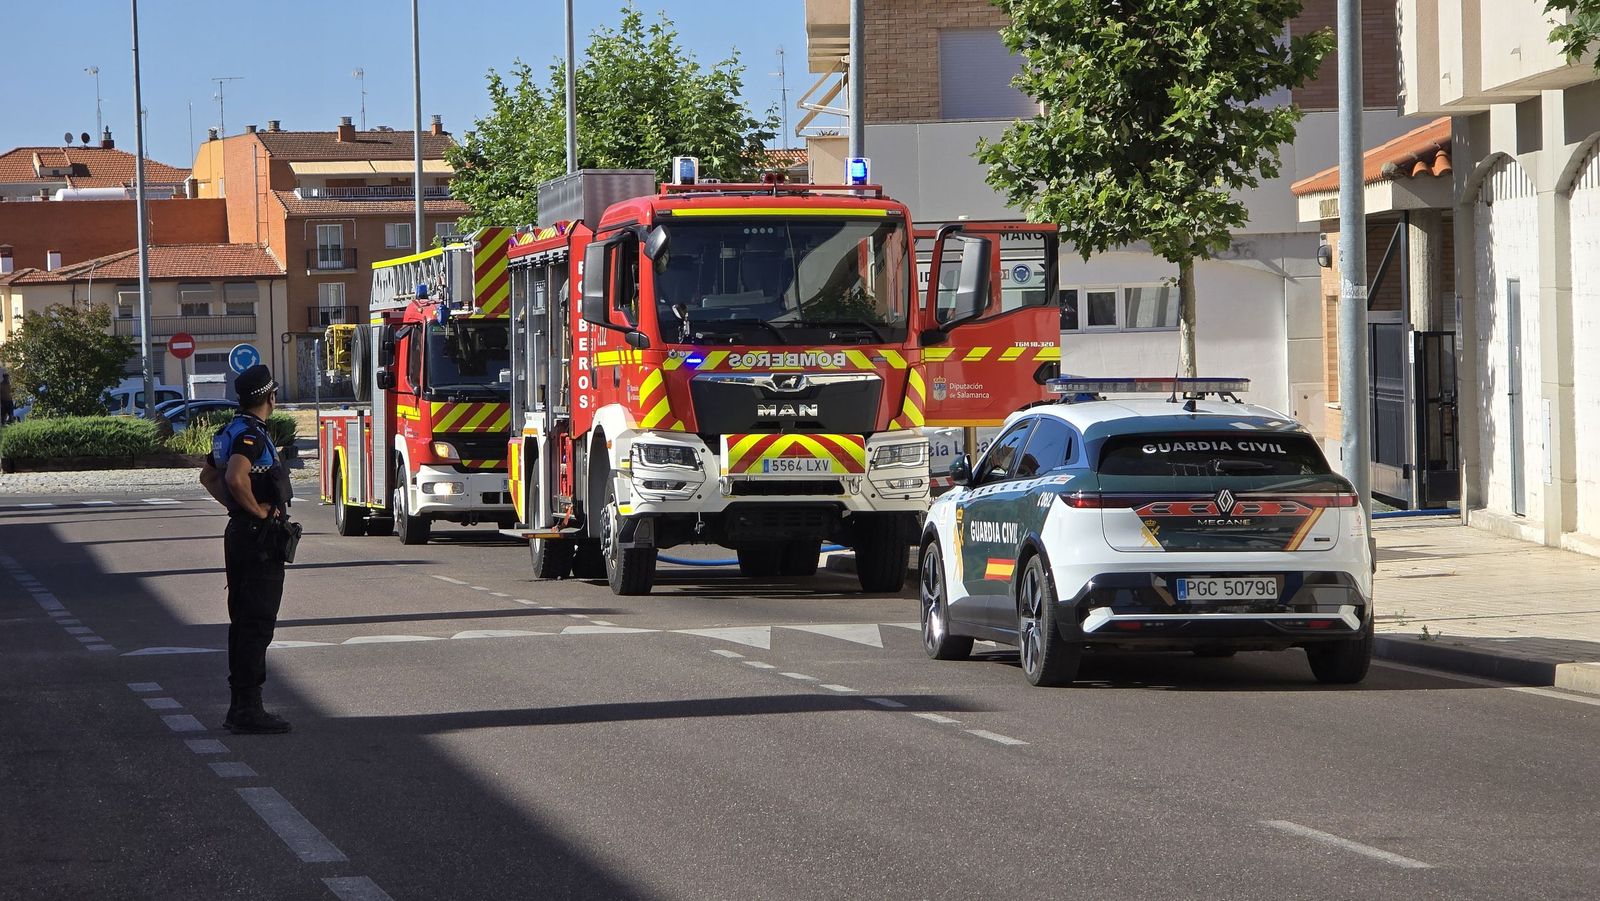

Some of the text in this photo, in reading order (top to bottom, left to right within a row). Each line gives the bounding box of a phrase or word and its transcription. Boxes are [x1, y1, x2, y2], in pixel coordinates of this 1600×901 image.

[949, 382, 984, 391] Diputación
[956, 391, 990, 399] Salamanca
[757, 404, 818, 417] MAN
[1142, 441, 1287, 454] GUARDIA CIVIL
[772, 459, 830, 472] 5564 LXV
[1197, 518, 1251, 526] MEGANE
[970, 520, 1018, 544] GUARDIA CIVIL
[1186, 580, 1276, 597] PGC 5079G
